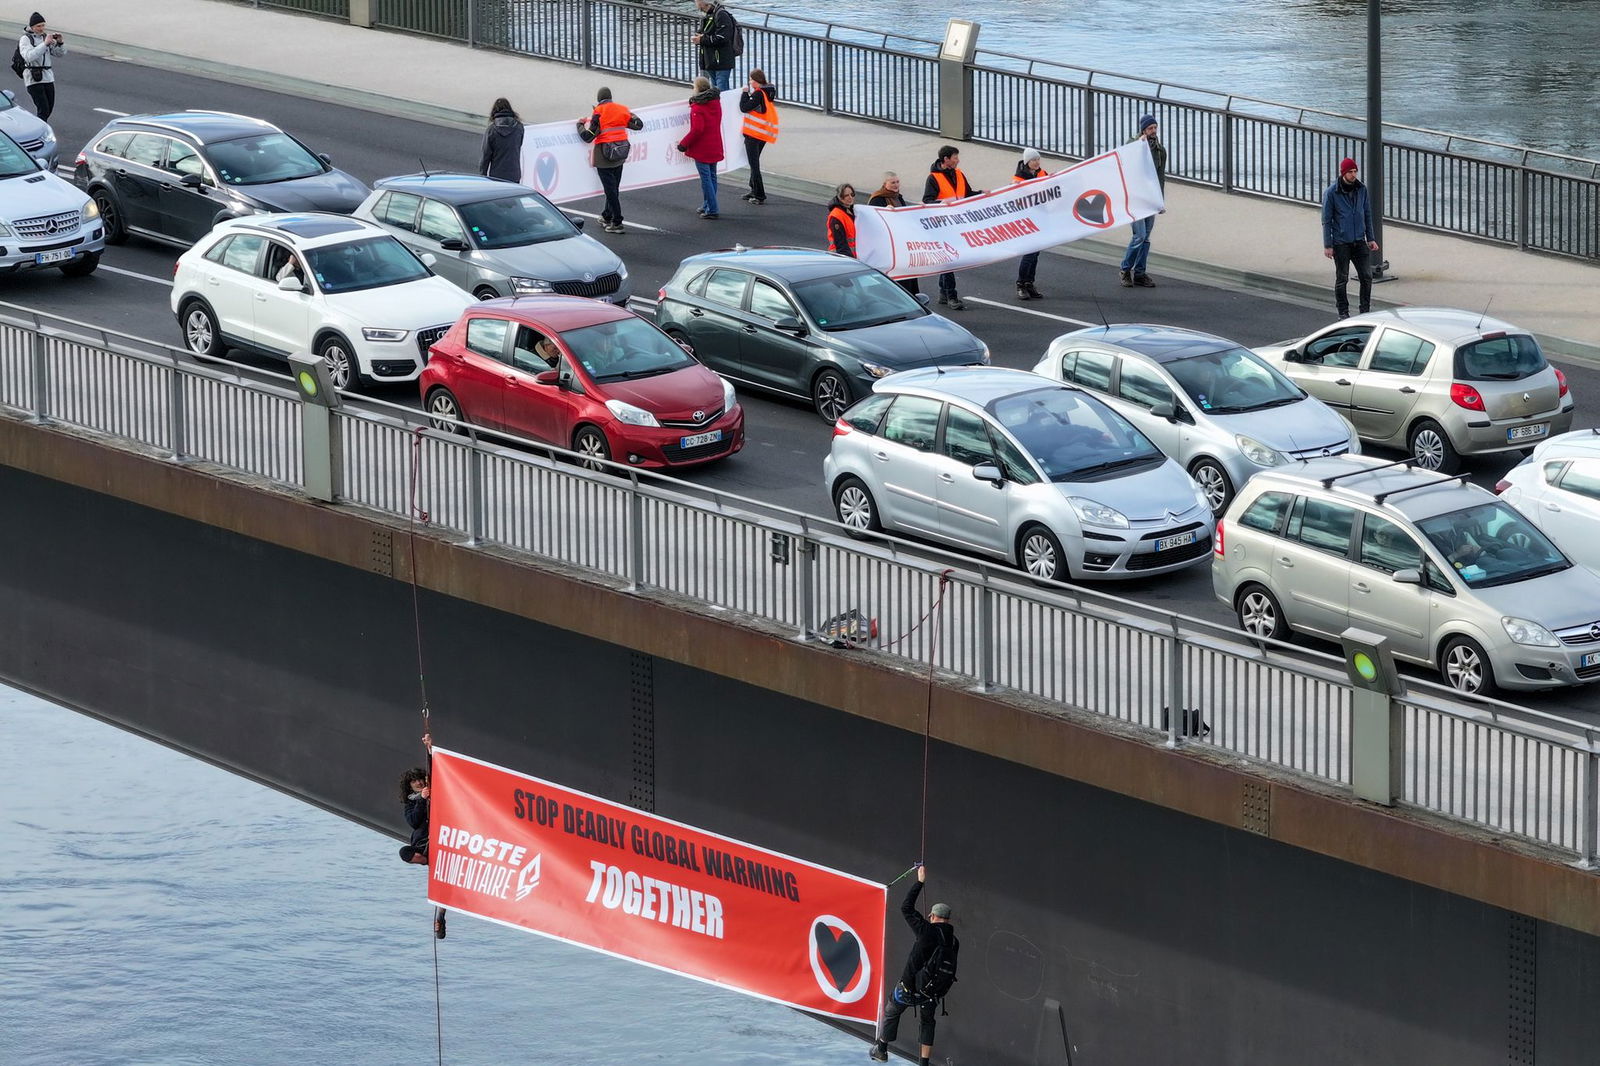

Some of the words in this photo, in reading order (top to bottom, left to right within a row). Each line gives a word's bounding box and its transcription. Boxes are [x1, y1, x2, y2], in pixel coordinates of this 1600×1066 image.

[920, 214, 953, 230] STOPPT
[951, 213, 964, 225] DIE
[963, 203, 1005, 224] TÖDLICHE
[1004, 185, 1062, 213] ERHITZUNG
[906, 240, 943, 251] RIPOSTE
[960, 217, 1040, 248] ZUSAMMEN
[438, 824, 527, 866] RIPOSTE
[513, 788, 559, 828] STOP
[563, 803, 626, 850] DEADLY
[631, 824, 700, 873] GLOBAL
[701, 845, 800, 903] WARMING
[433, 849, 517, 900] ALIMENTAIRE
[585, 859, 724, 940] TOGETHER
